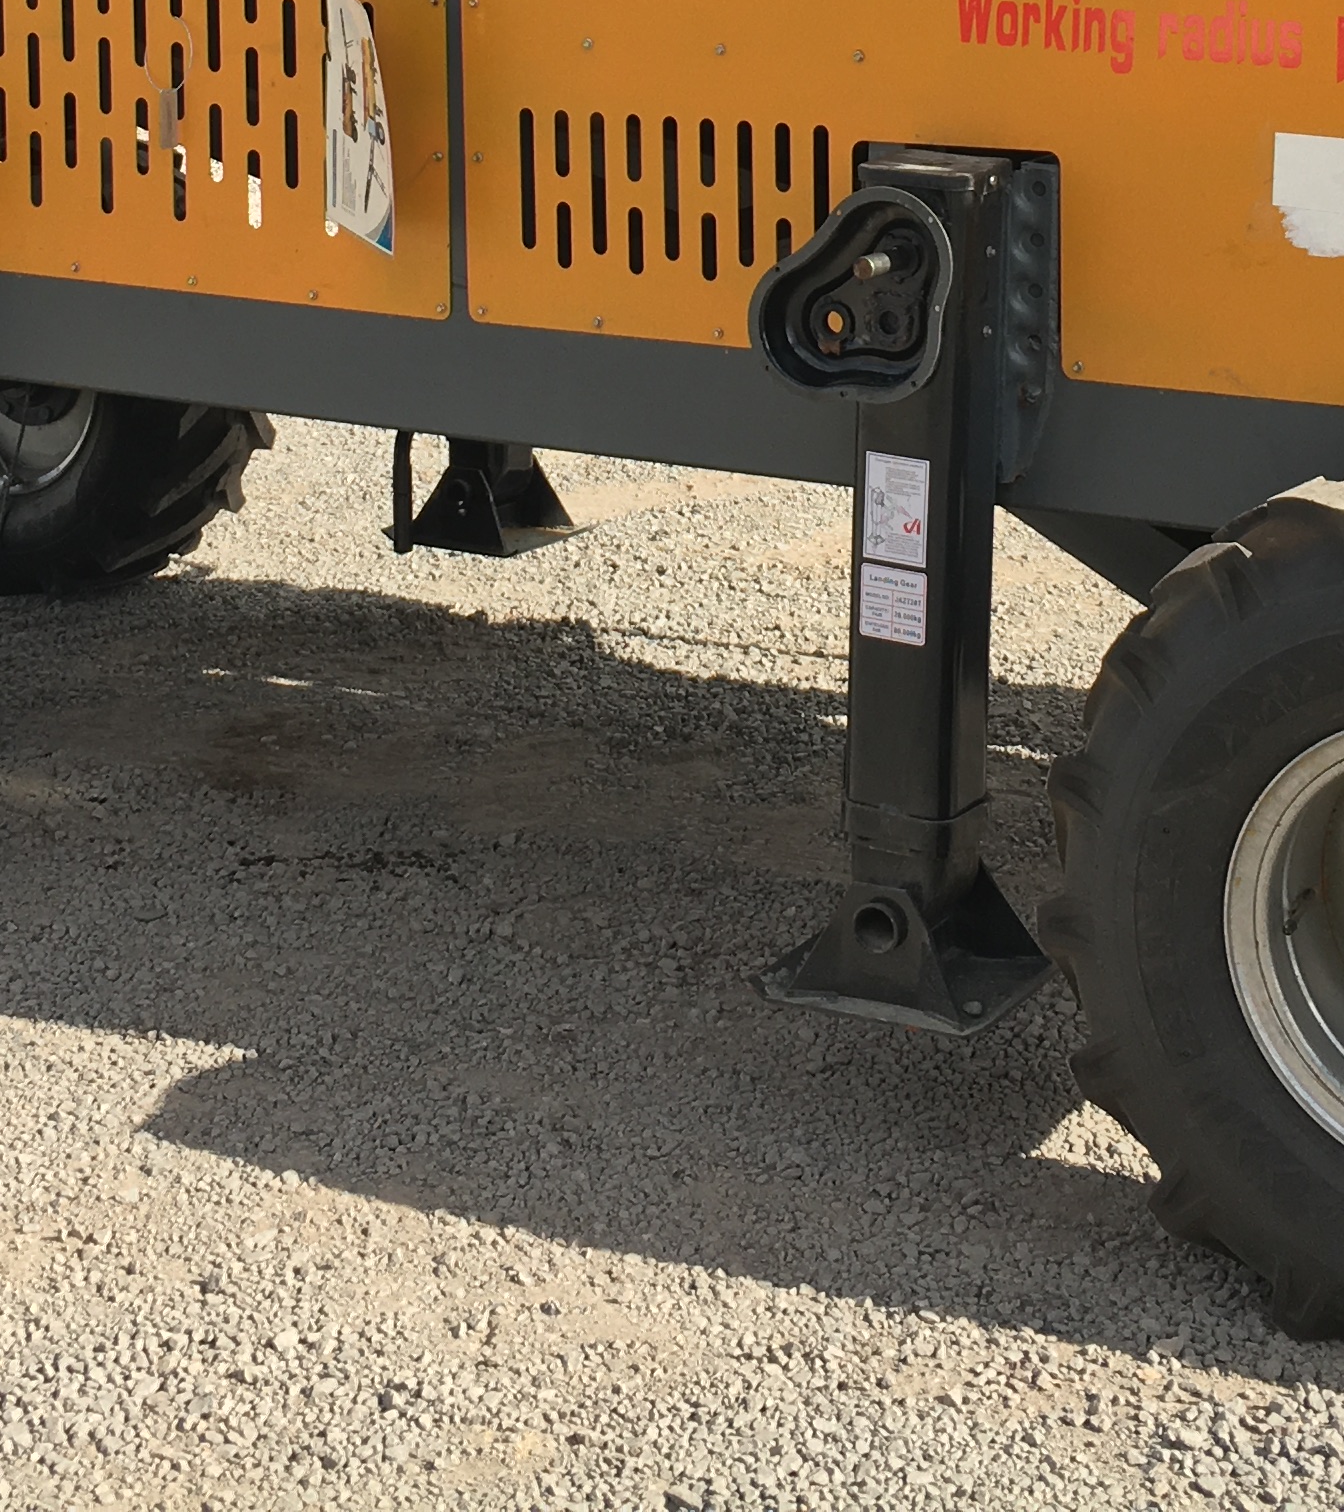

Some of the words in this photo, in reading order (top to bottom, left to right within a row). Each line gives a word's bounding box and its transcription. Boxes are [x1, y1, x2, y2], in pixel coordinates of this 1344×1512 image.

[1158, 0, 1304, 69] radius
[869, 574, 899, 587] Landing
[900, 578, 918, 589] Gear
